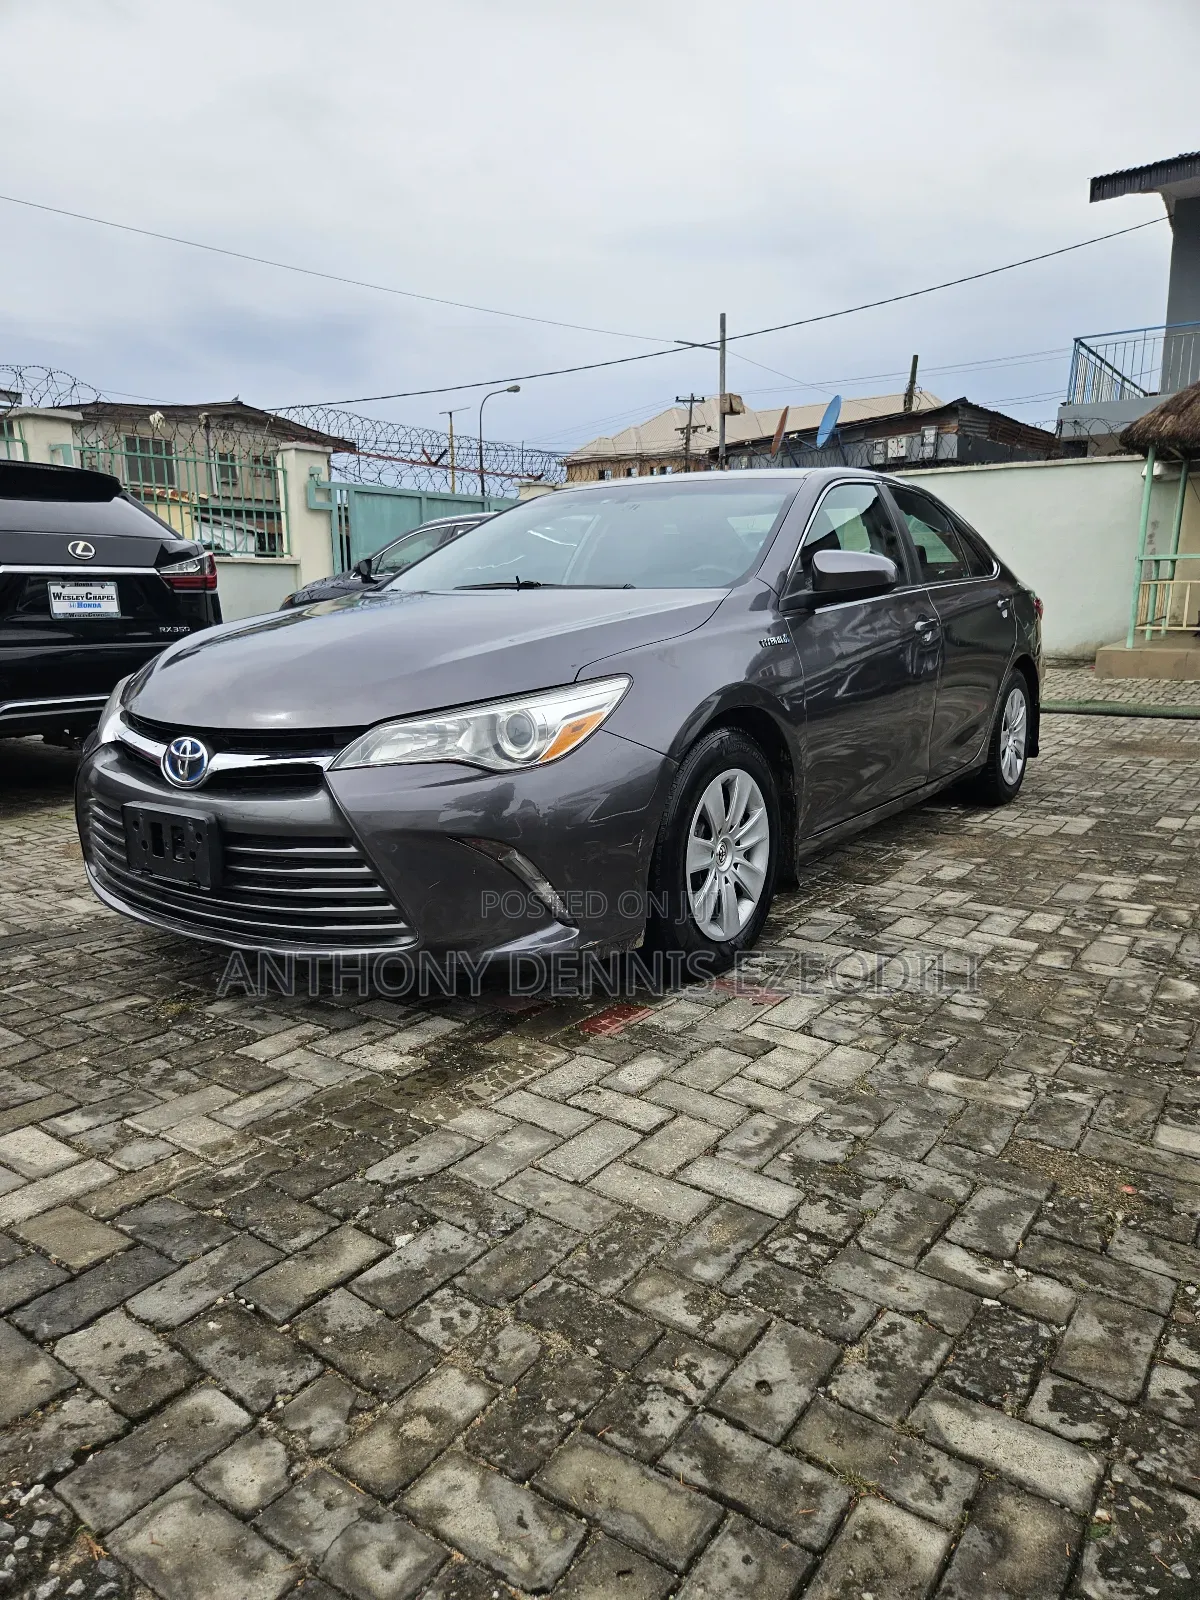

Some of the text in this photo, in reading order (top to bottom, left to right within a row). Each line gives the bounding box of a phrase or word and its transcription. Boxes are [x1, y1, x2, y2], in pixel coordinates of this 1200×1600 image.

[52, 592, 115, 601] WESLEY CHAPEL
[76, 601, 102, 609] HONDA
